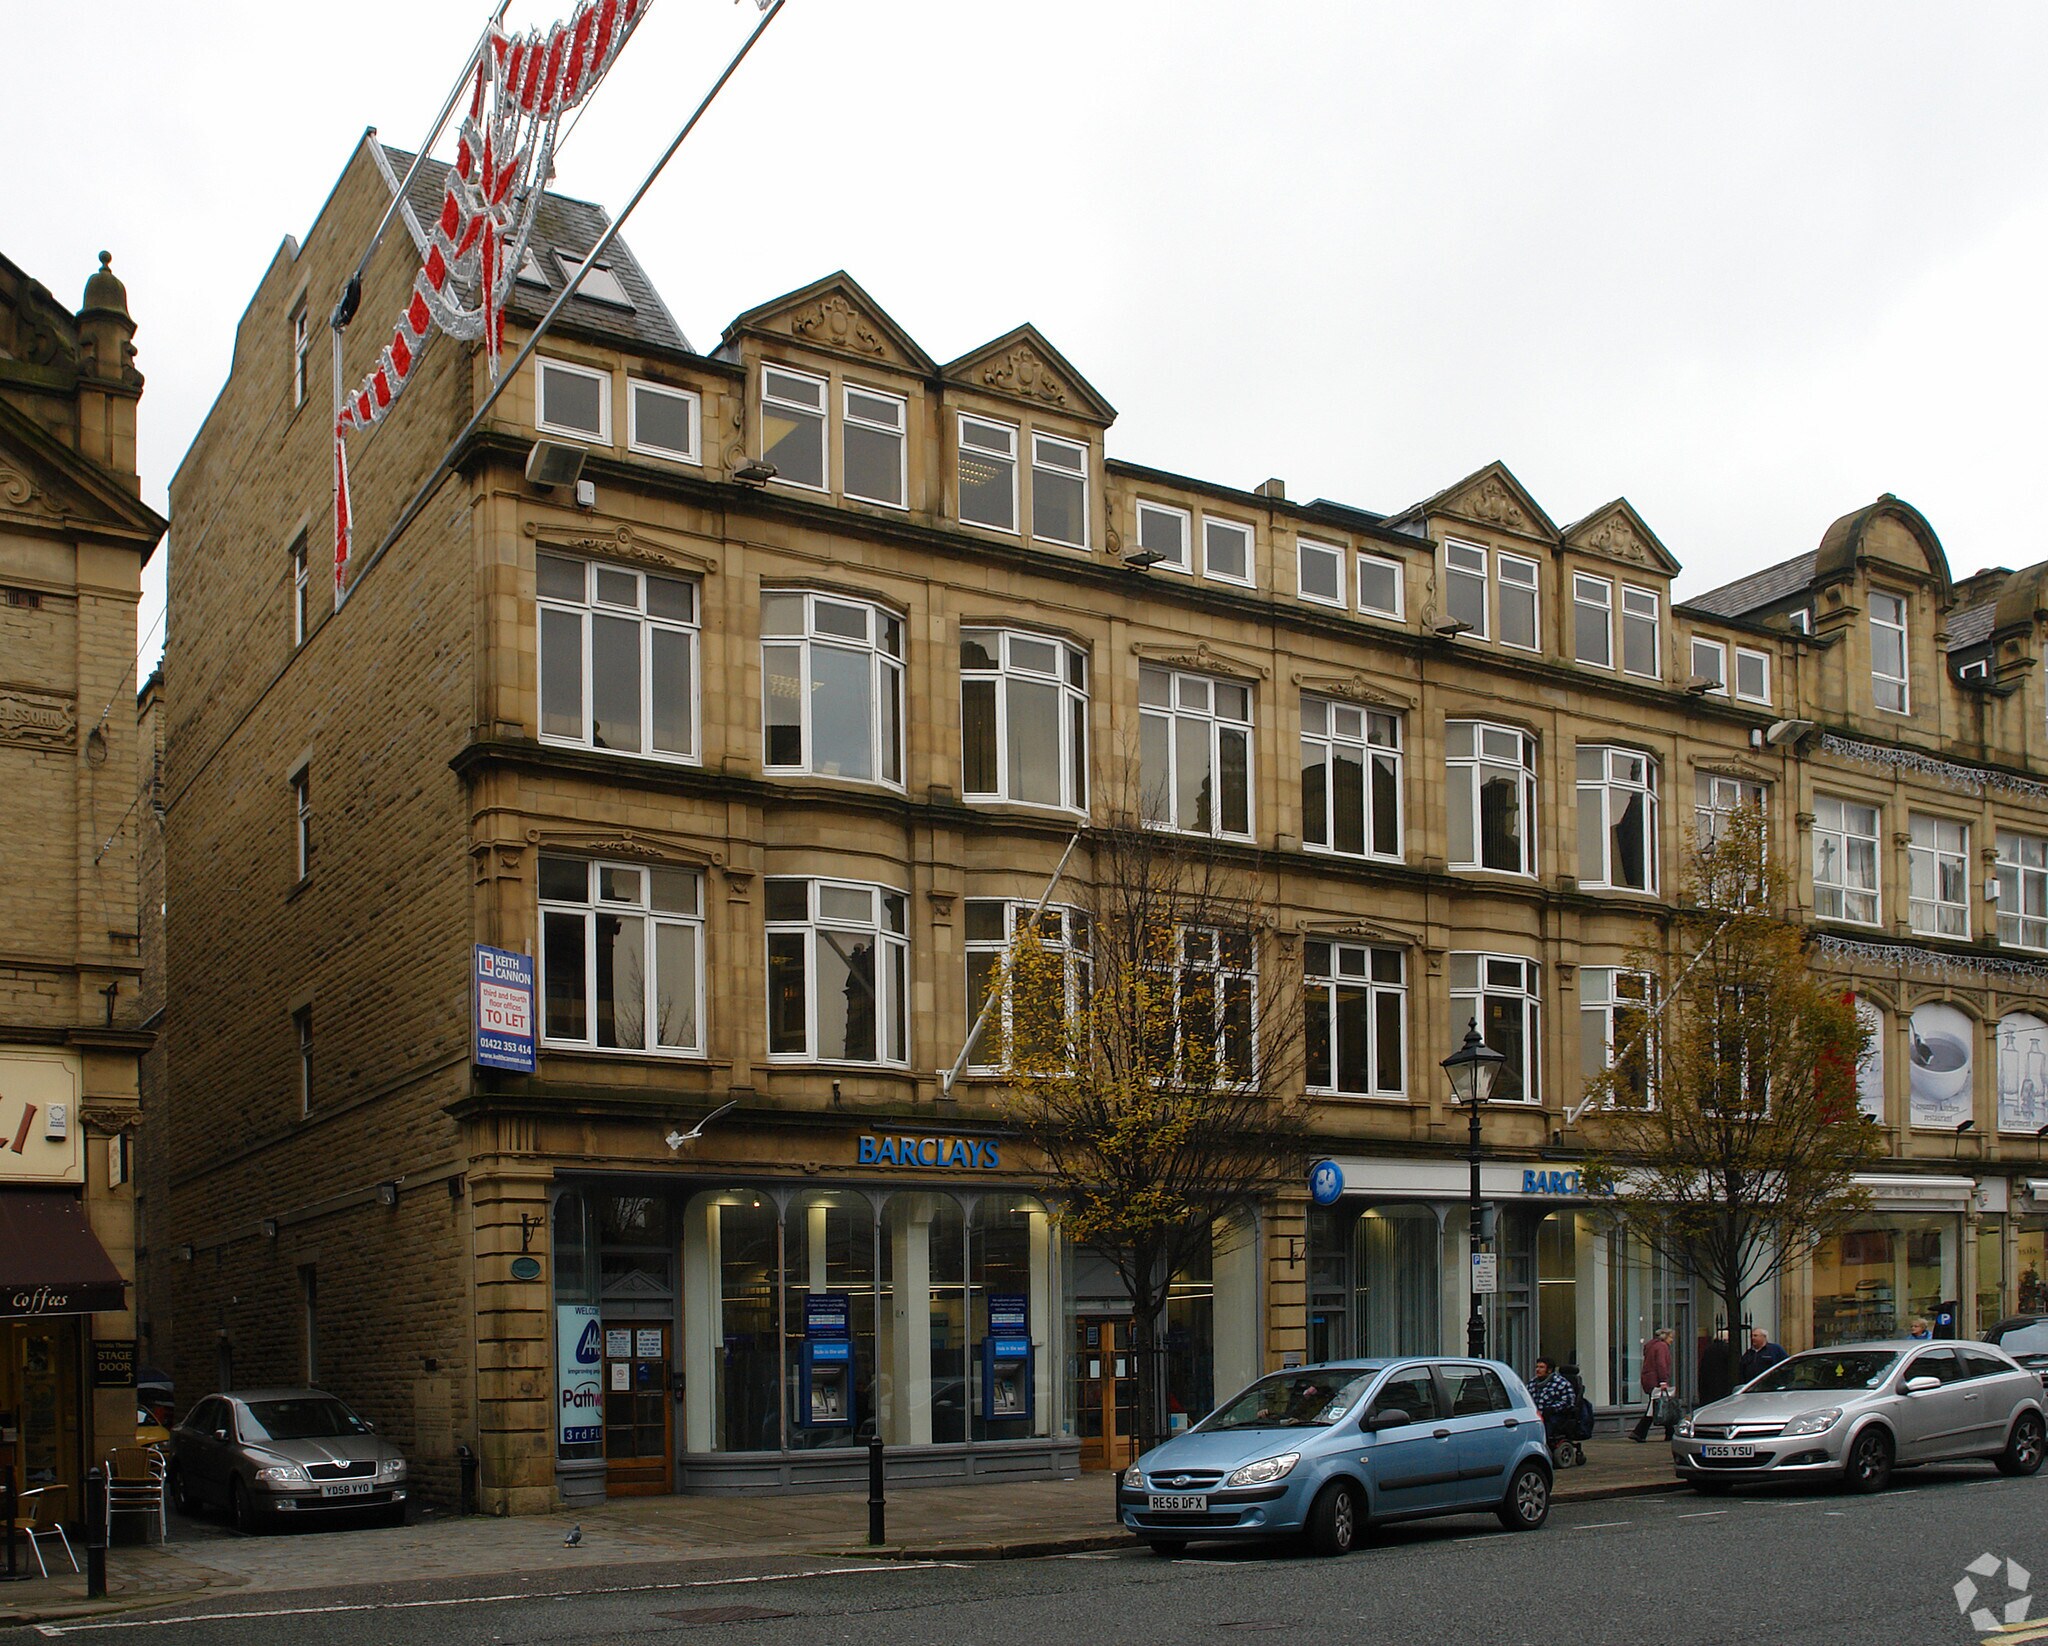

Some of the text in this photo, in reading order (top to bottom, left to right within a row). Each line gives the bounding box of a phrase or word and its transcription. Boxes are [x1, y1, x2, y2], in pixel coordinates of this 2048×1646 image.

[495, 955, 519, 970] KEITH
[495, 968, 531, 985] CANNON
[483, 988, 527, 1003] third and fourth
[489, 998, 522, 1012] floor offices
[485, 1009, 525, 1028] TO LET
[480, 1037, 531, 1055] 01422 353 414
[858, 1135, 1000, 1168] BARCLAYS
[12, 1287, 68, 1313] Coffees
[1941, 1314, 1951, 1325] P
[97, 1351, 133, 1361] STAGE
[98, 1362, 132, 1371] DOOR
[1731, 1446, 1752, 1456] YSU
[326, 1483, 369, 1495] YD58 VYO
[1152, 1496, 1203, 1509] RE56 DFX
